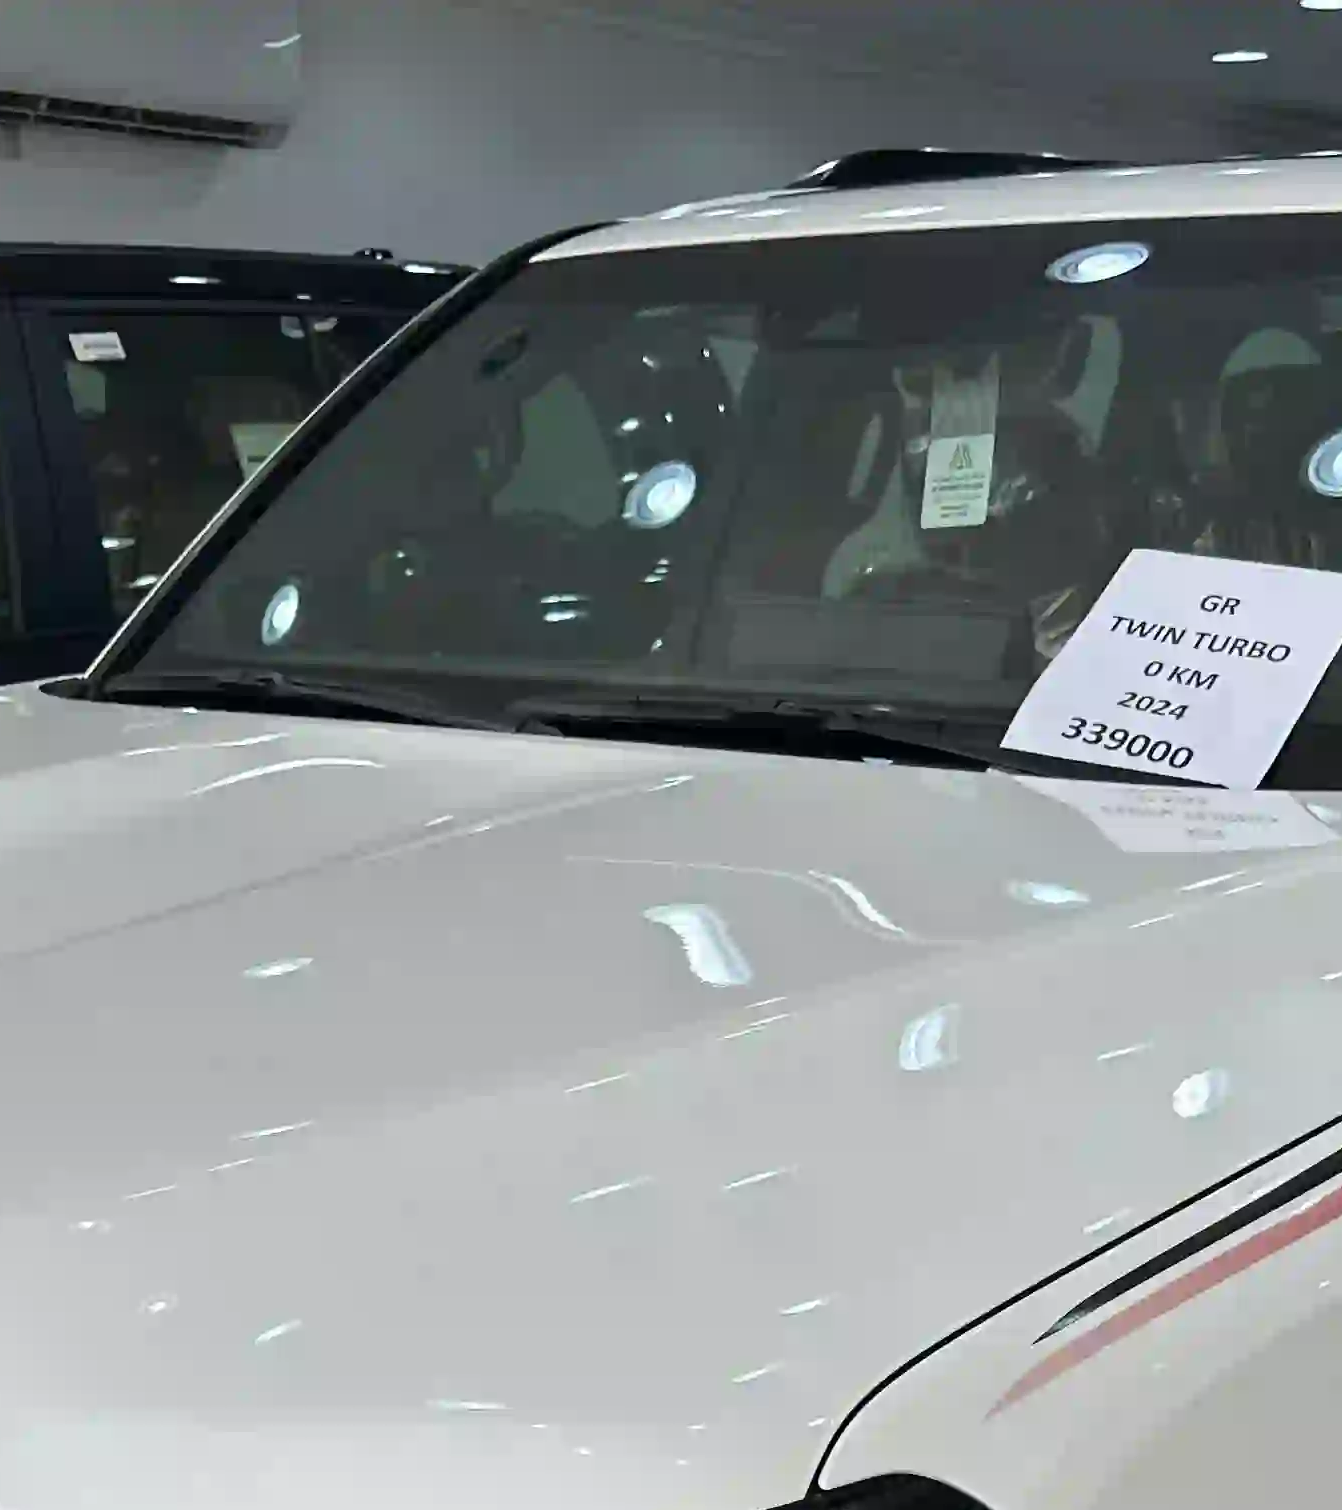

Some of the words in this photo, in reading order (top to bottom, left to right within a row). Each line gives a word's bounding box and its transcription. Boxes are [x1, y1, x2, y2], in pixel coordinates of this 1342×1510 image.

[1199, 594, 1241, 616] GR
[1109, 615, 1187, 645] TWIN
[1192, 632, 1292, 663] TURBO
[1143, 660, 1164, 677] 0
[1167, 665, 1220, 691] KM
[1116, 691, 1189, 720] 2024
[1060, 716, 1195, 769] 339000
